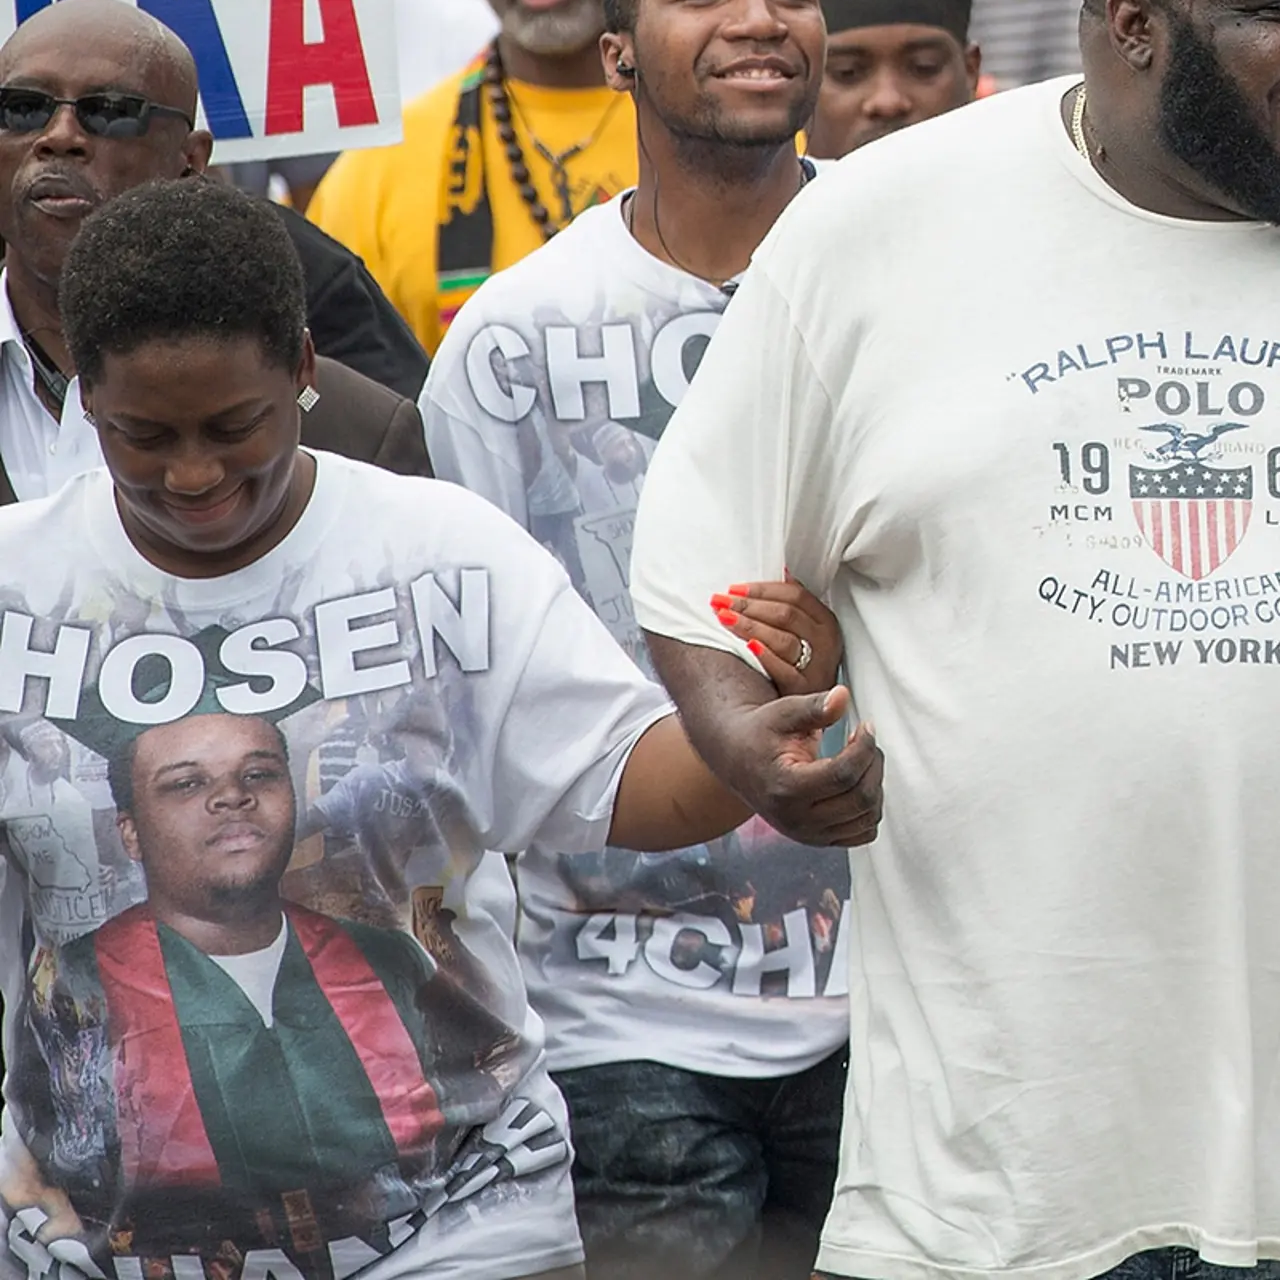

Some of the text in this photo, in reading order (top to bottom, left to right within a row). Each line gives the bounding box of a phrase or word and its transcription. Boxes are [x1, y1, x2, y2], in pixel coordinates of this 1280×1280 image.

[1156, 365, 1223, 377] TRADEMARK
[1117, 378, 1265, 417] POLO
[1053, 442, 1111, 495] 19
[1051, 504, 1113, 521] MCM
[1111, 602, 1250, 632] OUTDOOR
[0, 568, 490, 725] HOSEN
[1110, 640, 1183, 670] NEW
